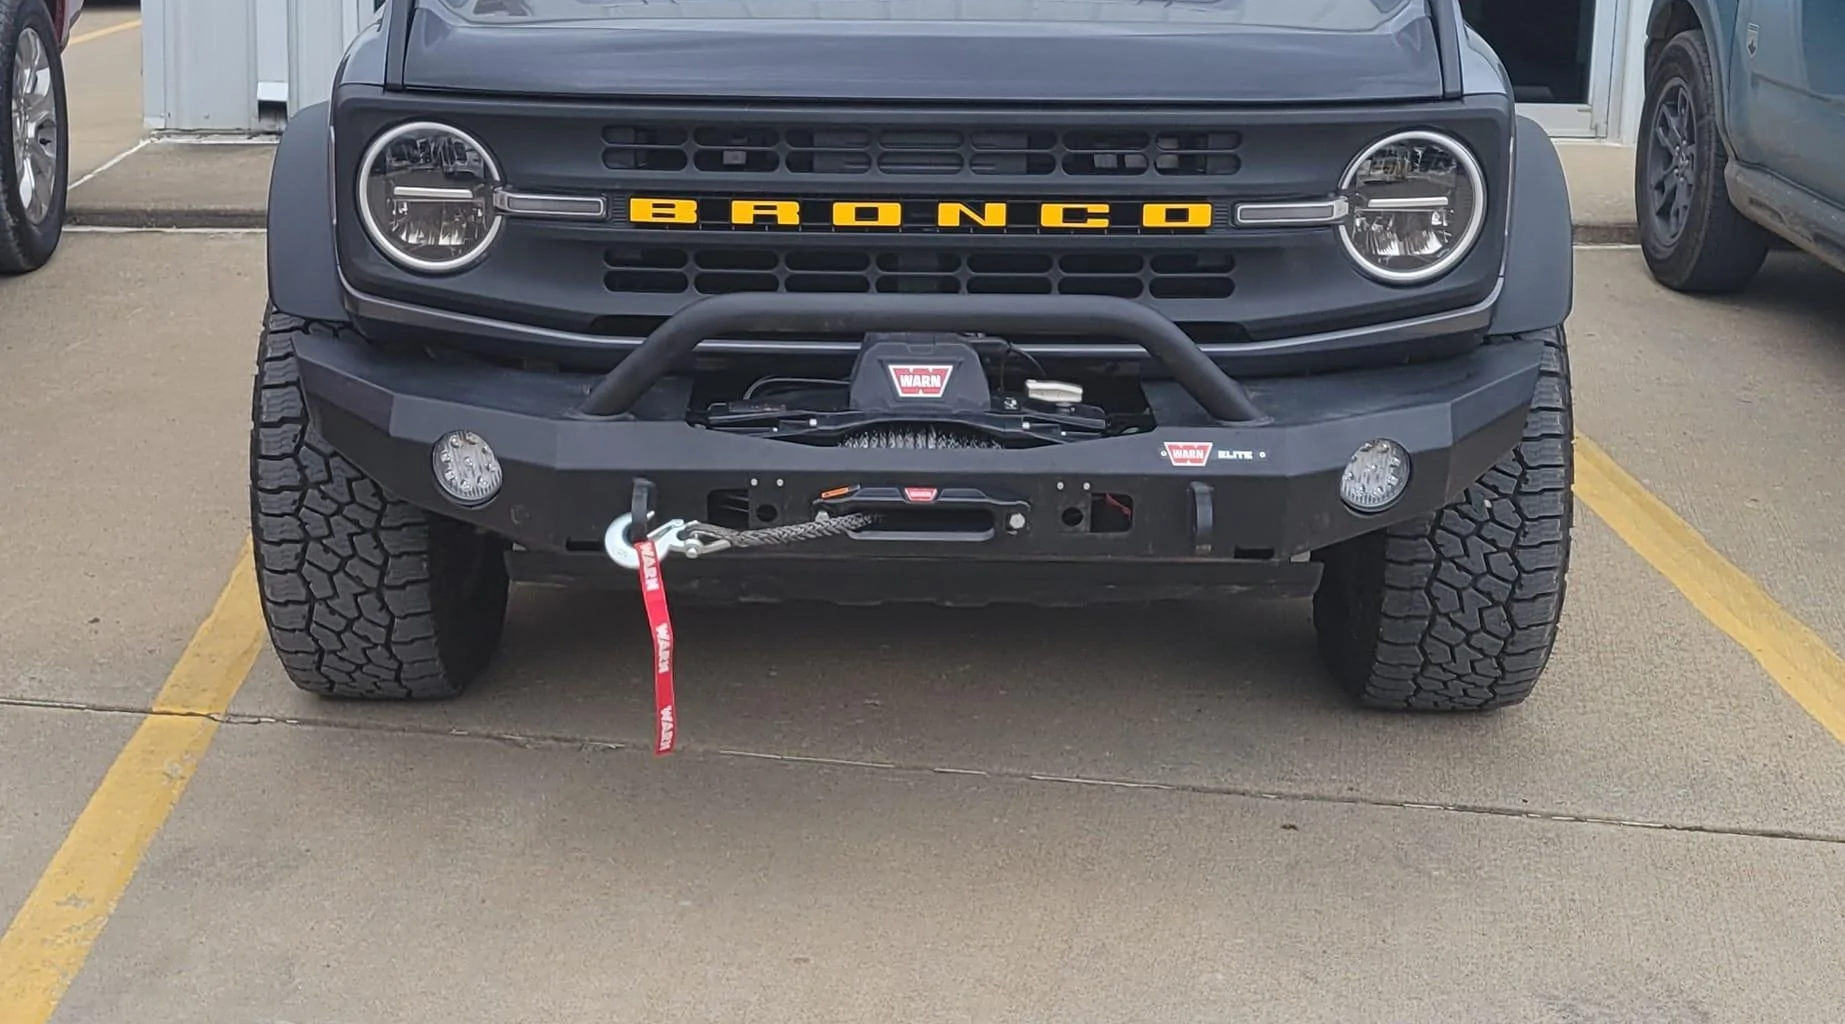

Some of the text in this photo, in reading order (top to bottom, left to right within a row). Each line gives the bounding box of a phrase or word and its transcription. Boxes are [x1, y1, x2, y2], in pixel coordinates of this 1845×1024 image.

[628, 197, 1213, 228] BRONCO
[899, 374, 941, 388] WARN
[1171, 448, 1253, 460] WARN ELITE
[640, 543, 660, 591] WARN
[656, 622, 670, 674] WARN
[660, 704, 674, 751] WARN
